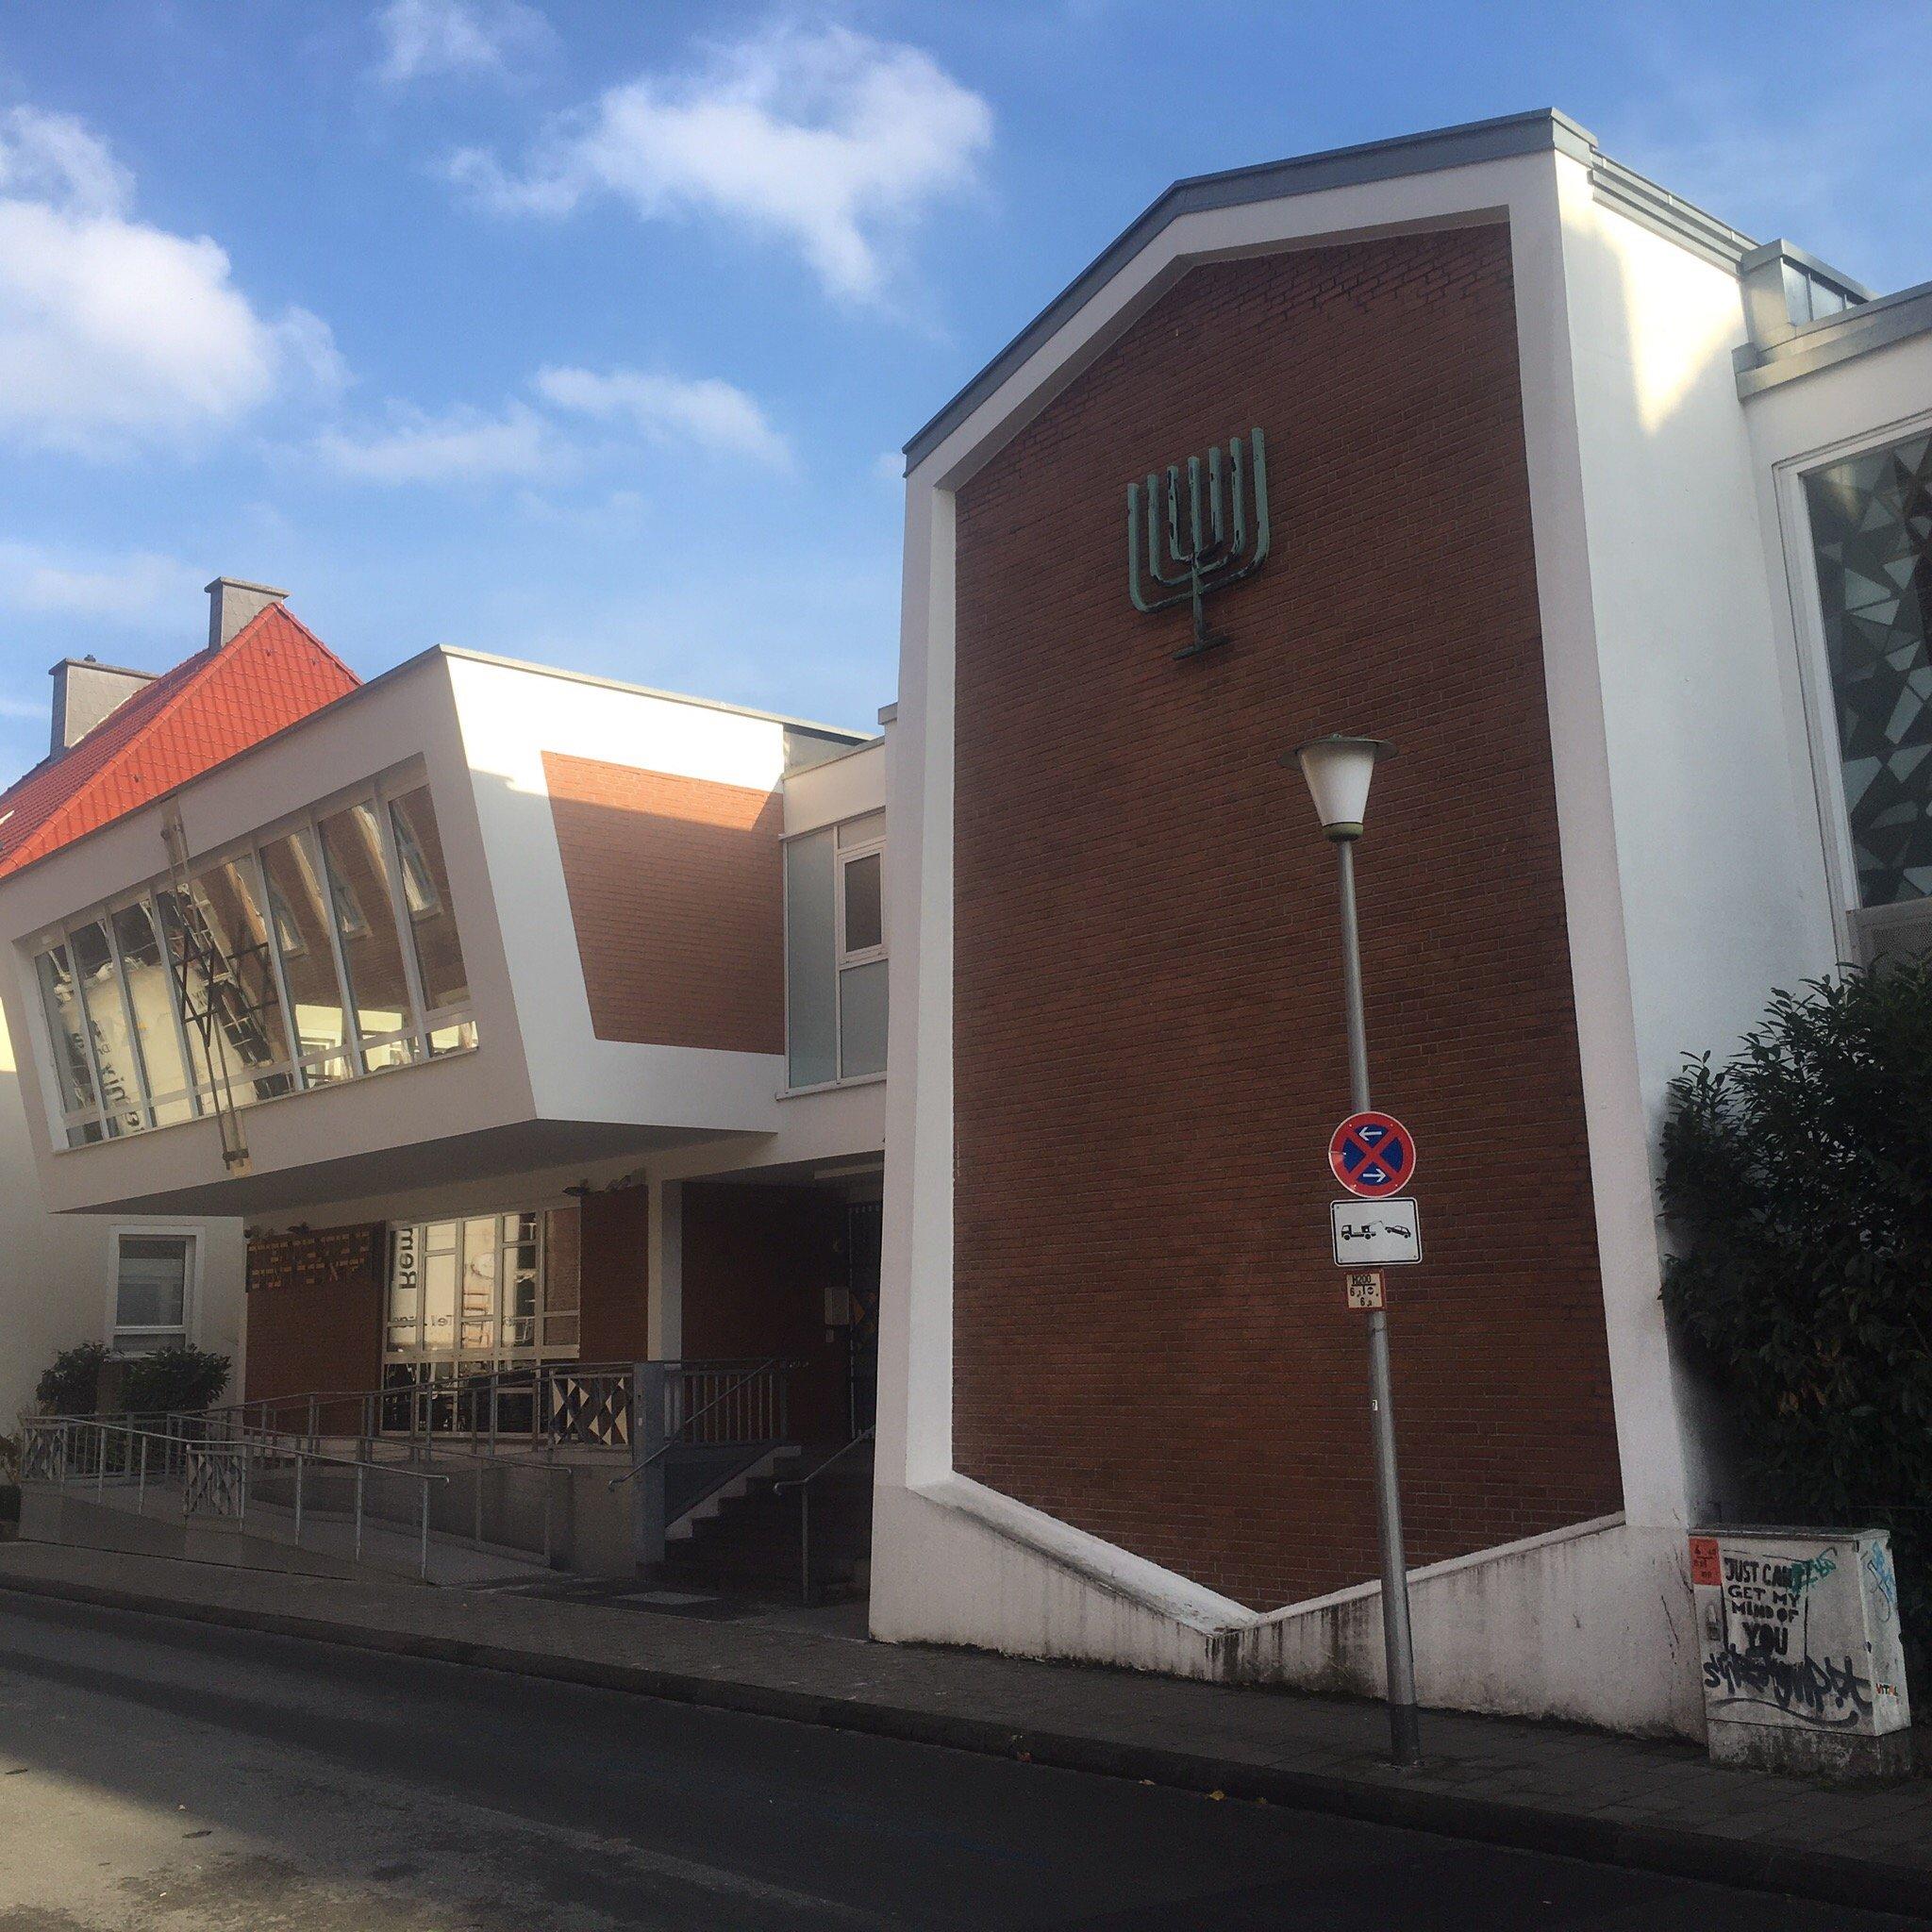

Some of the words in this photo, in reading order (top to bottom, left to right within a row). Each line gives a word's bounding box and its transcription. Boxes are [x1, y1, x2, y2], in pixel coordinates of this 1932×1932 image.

[1724, 1557, 1759, 1583] JUST
[1728, 1585, 1766, 1601] GET
[1773, 1591, 1801, 1607] MY
[1732, 1601, 1774, 1619] MIND
[1777, 1607, 1799, 1623] OF
[1741, 1622, 1789, 1656] YOU
